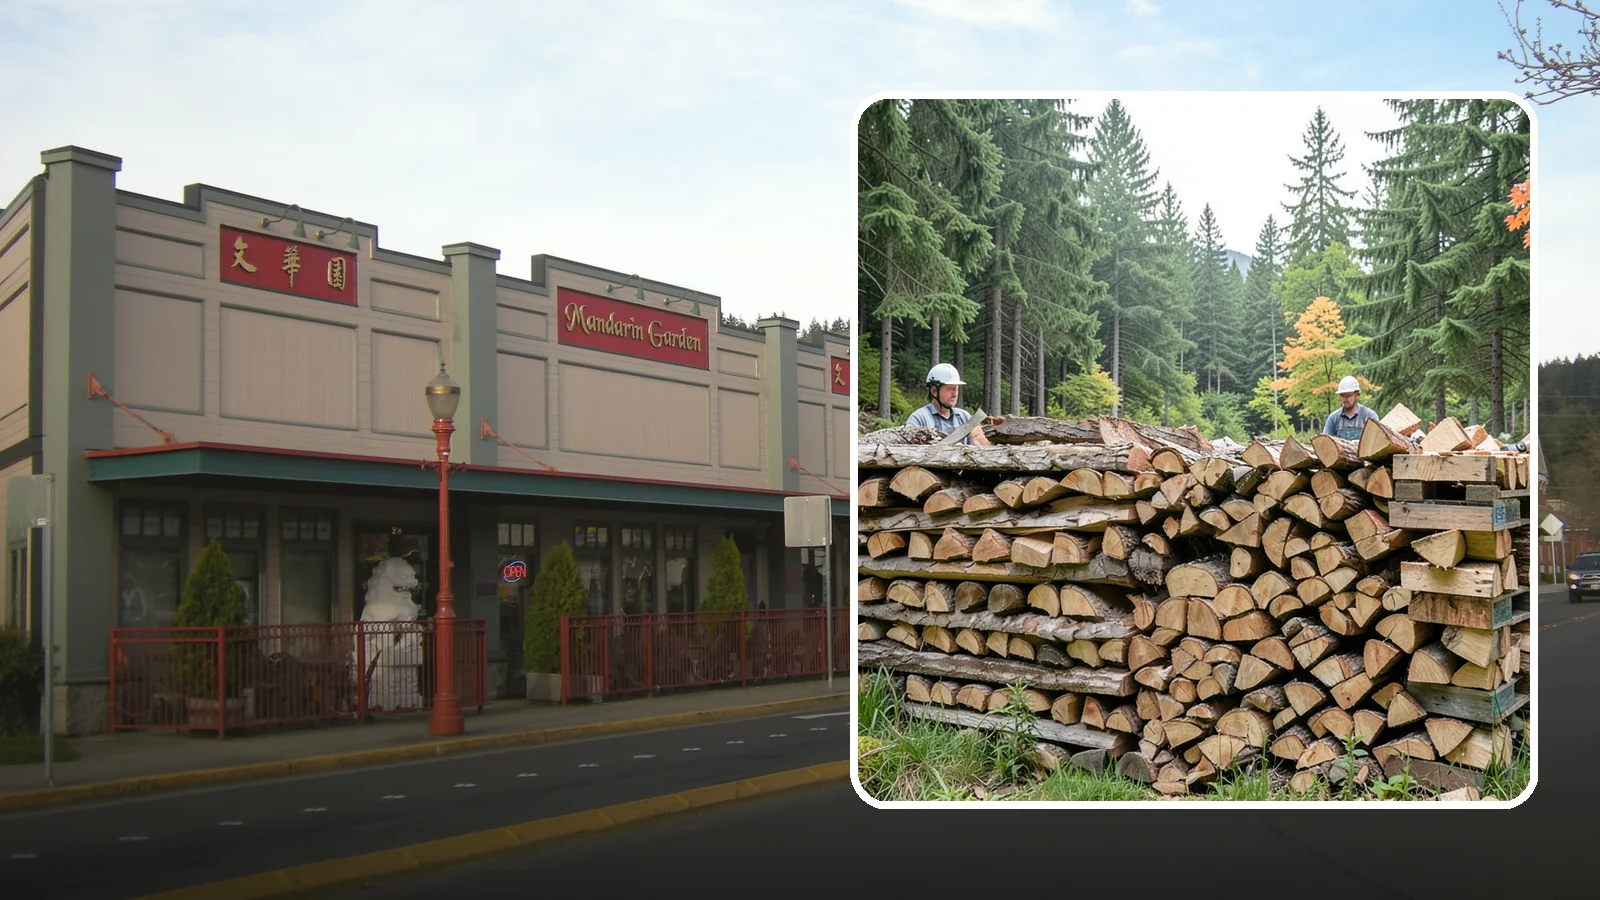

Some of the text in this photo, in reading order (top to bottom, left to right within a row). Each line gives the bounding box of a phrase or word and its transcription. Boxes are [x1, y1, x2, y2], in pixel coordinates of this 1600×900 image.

[231, 236, 346, 291] 文華園
[564, 302, 702, 352] Mandarin Garden
[503, 565, 527, 578] OPEN
